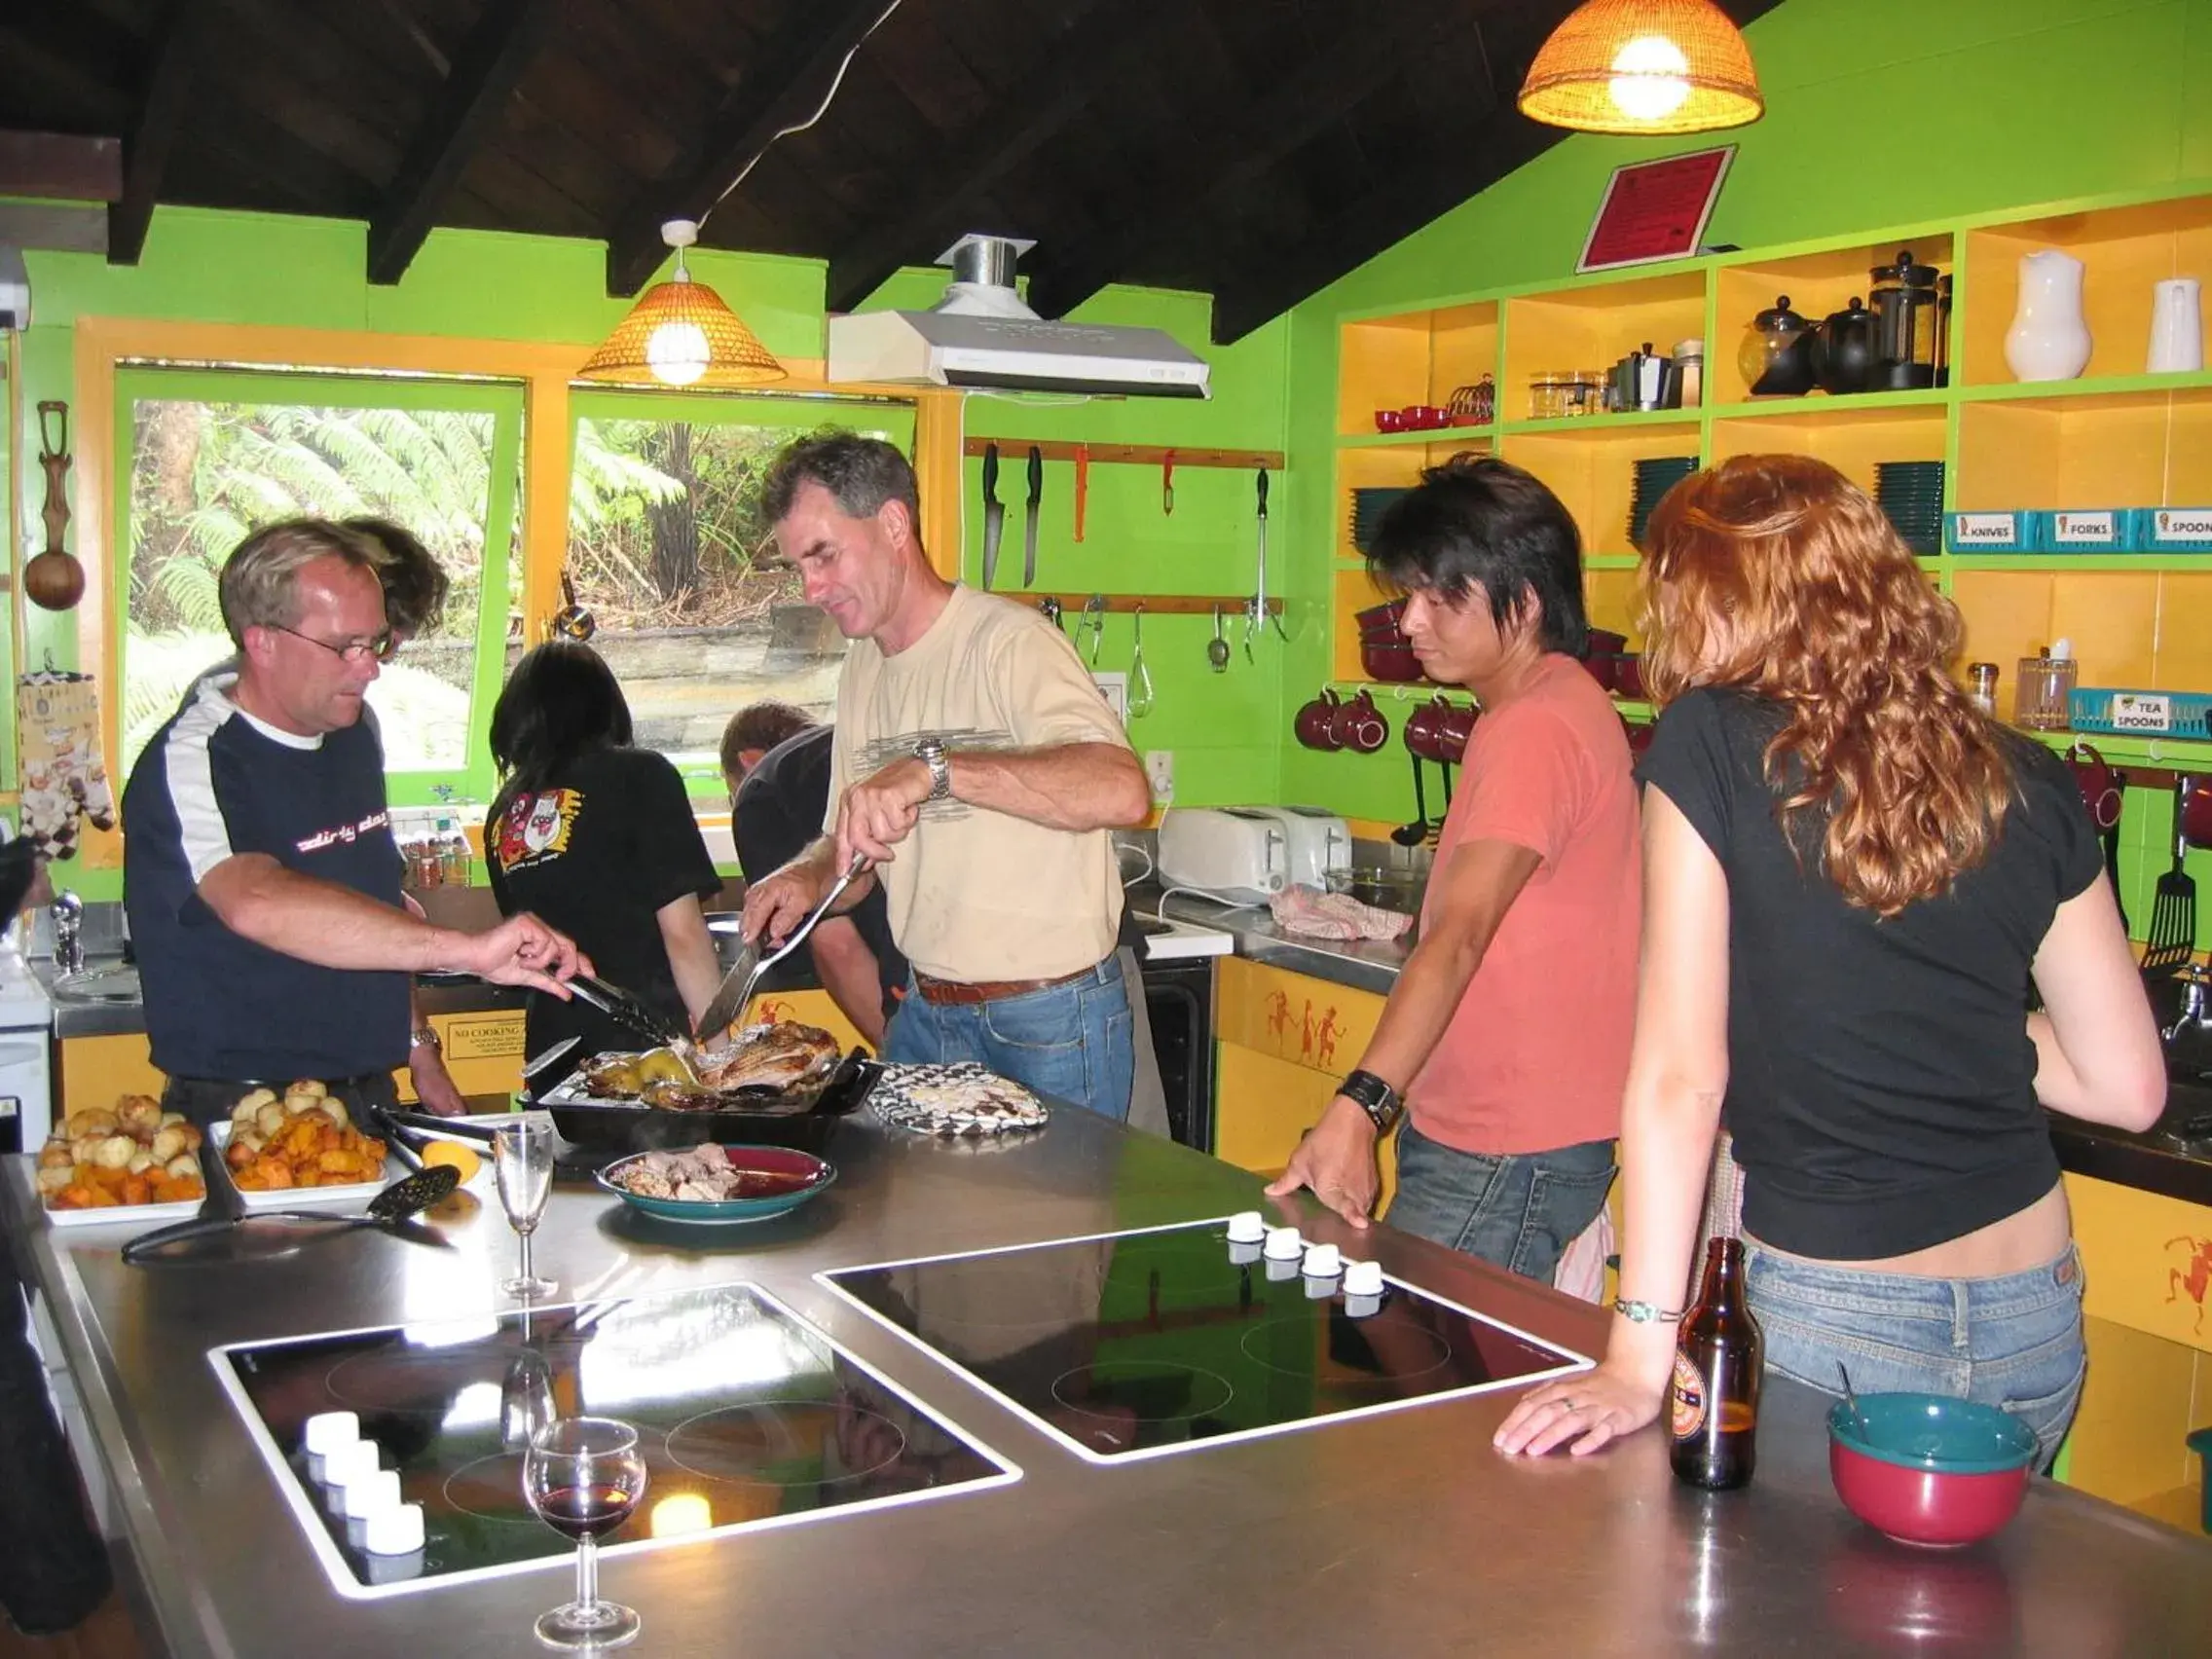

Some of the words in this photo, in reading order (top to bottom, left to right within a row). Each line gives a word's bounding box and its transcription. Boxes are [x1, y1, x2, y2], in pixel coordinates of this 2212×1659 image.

[1971, 527, 2009, 537] KNIVES
[2070, 524, 2108, 535] FORKS
[2138, 703, 2161, 713] TEA
[2118, 716, 2164, 727] SPOONS
[471, 1026, 520, 1037] COOKING
